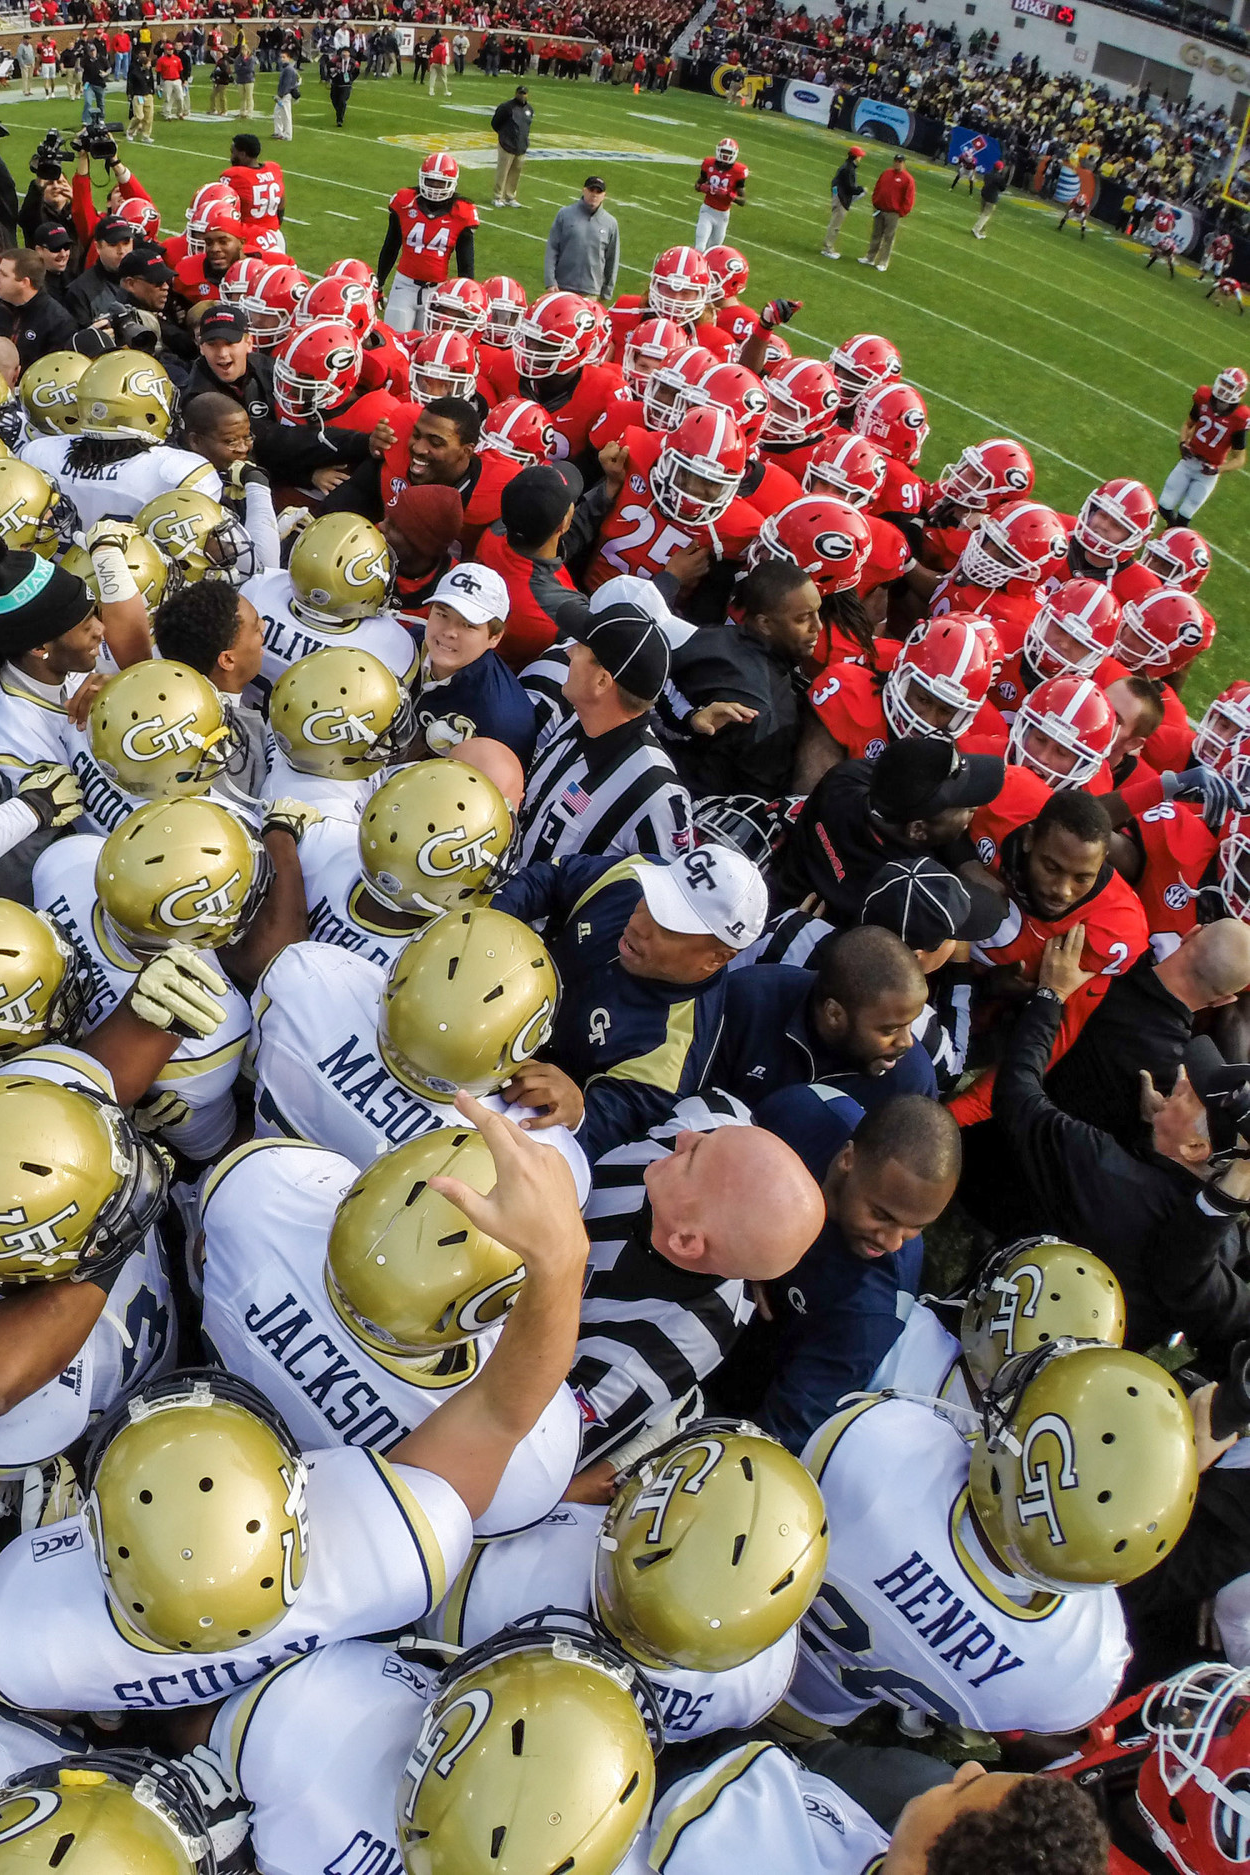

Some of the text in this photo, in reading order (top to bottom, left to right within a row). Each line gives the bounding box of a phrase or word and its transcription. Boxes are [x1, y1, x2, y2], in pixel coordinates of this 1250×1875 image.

[1058, 7, 1074, 23] 25
[250, 183, 281, 219] 56
[255, 230, 277, 251] 94
[406, 221, 451, 257] 44
[732, 316, 754, 336] 64
[31, 380, 78, 408] GT
[128, 369, 168, 405] GT
[1195, 415, 1228, 449] 27
[900, 483, 921, 509] 91
[148, 510, 203, 546] GT
[601, 505, 691, 581] 25
[450, 572, 482, 596] GT
[812, 676, 841, 706] 3
[122, 712, 204, 763] GT
[302, 706, 376, 746] GT
[417, 827, 498, 878] GT
[683, 849, 717, 891] GT
[815, 822, 846, 884] GEORGIA
[158, 868, 242, 928] GT
[1102, 942, 1129, 974] 2
[589, 1006, 611, 1046] GT
[989, 1263, 1045, 1356] GT
[74, 1357, 84, 1397] RUSSELL
[631, 1438, 726, 1544] GT
[1018, 1412, 1080, 1546] GT
[37, 1530, 79, 1557] ACC
[873, 1550, 1025, 1689] HENRY
[387, 1661, 427, 1690] ACC
[406, 1688, 494, 1824] GT
[807, 1796, 844, 1832] ACC
